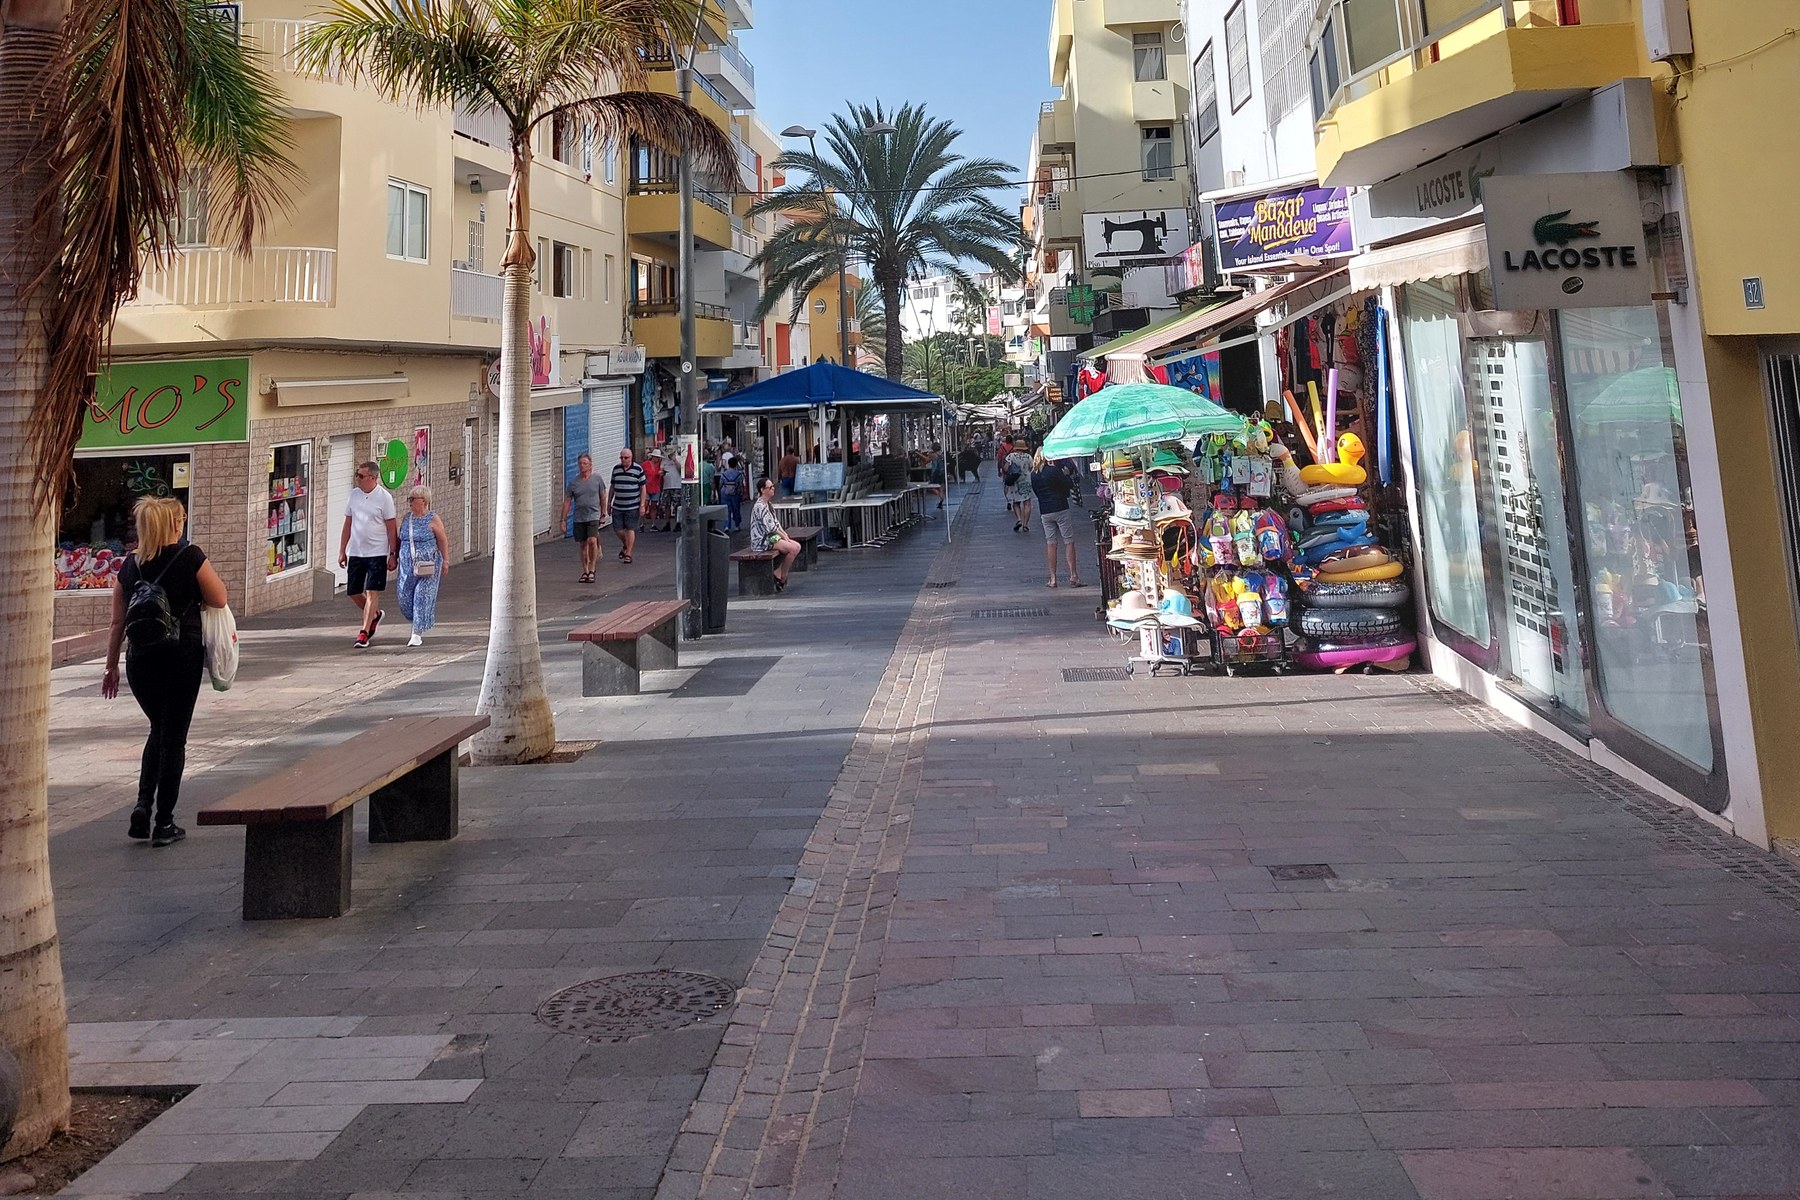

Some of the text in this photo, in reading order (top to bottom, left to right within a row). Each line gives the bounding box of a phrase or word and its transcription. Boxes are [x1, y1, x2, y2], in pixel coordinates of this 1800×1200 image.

[1416, 170, 1465, 212] LACOSTE
[1254, 196, 1305, 224] Bazar
[1248, 217, 1317, 246] Manodeva
[1088, 260, 1101, 268] Piso
[1234, 257, 1248, 267] Your
[1247, 253, 1264, 264] Island
[1310, 245, 1324, 255] One
[1324, 241, 1340, 254] Spot!
[1504, 246, 1637, 272] LACOSTE
[1746, 282, 1759, 303] 32
